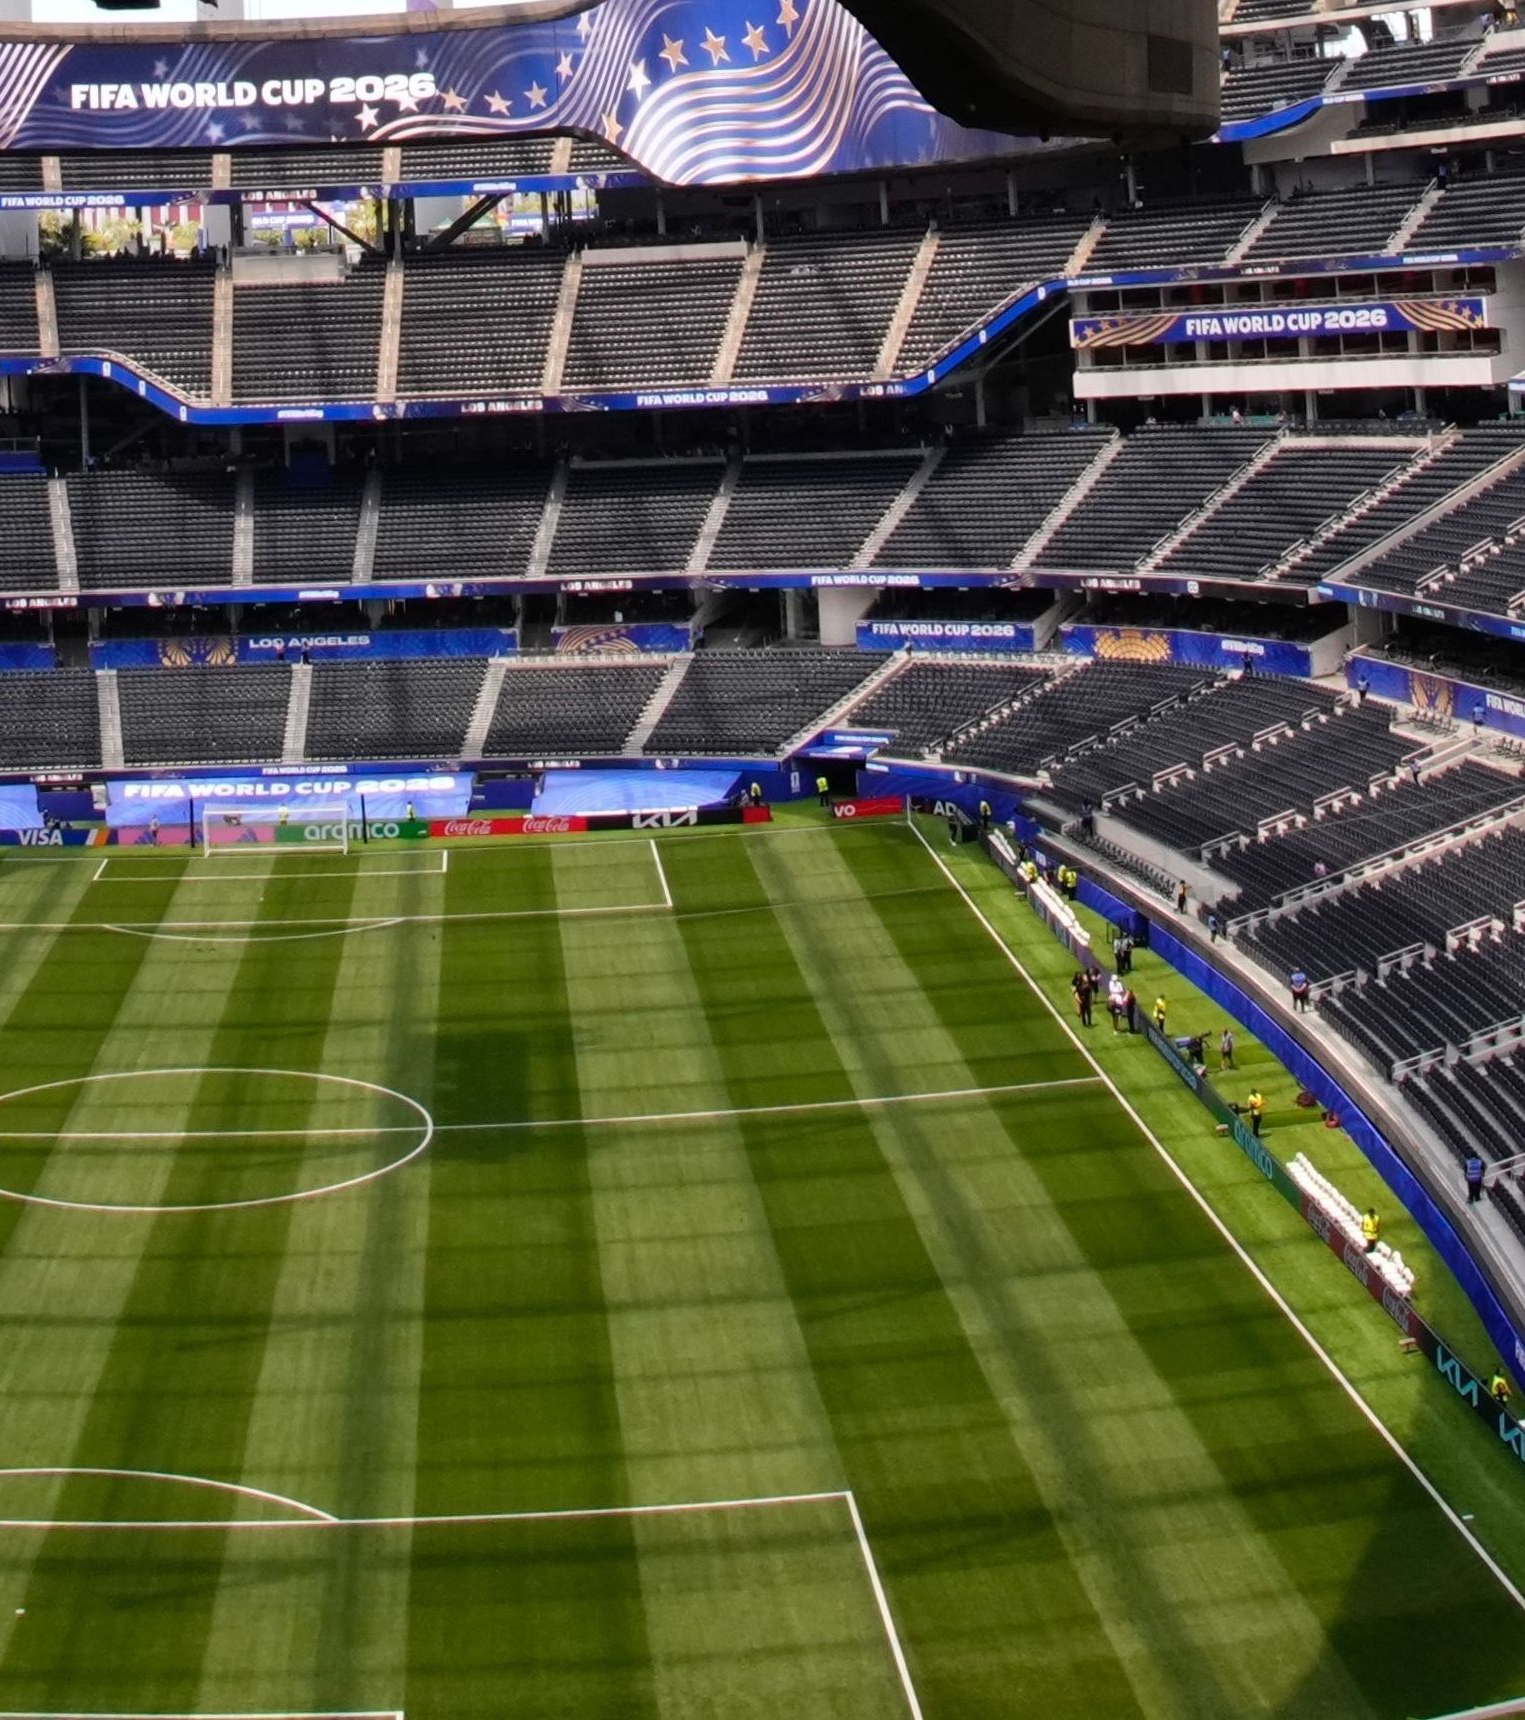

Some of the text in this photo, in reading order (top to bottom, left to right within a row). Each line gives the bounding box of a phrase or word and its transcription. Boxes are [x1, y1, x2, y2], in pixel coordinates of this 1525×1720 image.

[71, 73, 435, 109] FIFA WORLD CUP 2026
[1, 195, 124, 207] FIFA WORLD CUP 2026
[1186, 309, 1387, 336] FIFA WORLD CUP 2026
[637, 390, 768, 406] FIFA WORLD CUP 2026
[461, 400, 543, 413] LOS ANGELES
[811, 575, 920, 585] FIFA WORLD CUP 2026
[5, 597, 78, 609] LOS ANGELES
[872, 623, 1015, 637] FIFA WORLD CUP 2026
[249, 635, 370, 648] LOS ANGELES
[124, 776, 455, 798] FIFA WORLD CUP 2026
[632, 811, 698, 829] KIA
[18, 829, 63, 846] VISA
[304, 822, 400, 840] aramco
[1437, 1345, 1478, 1408] KIA
